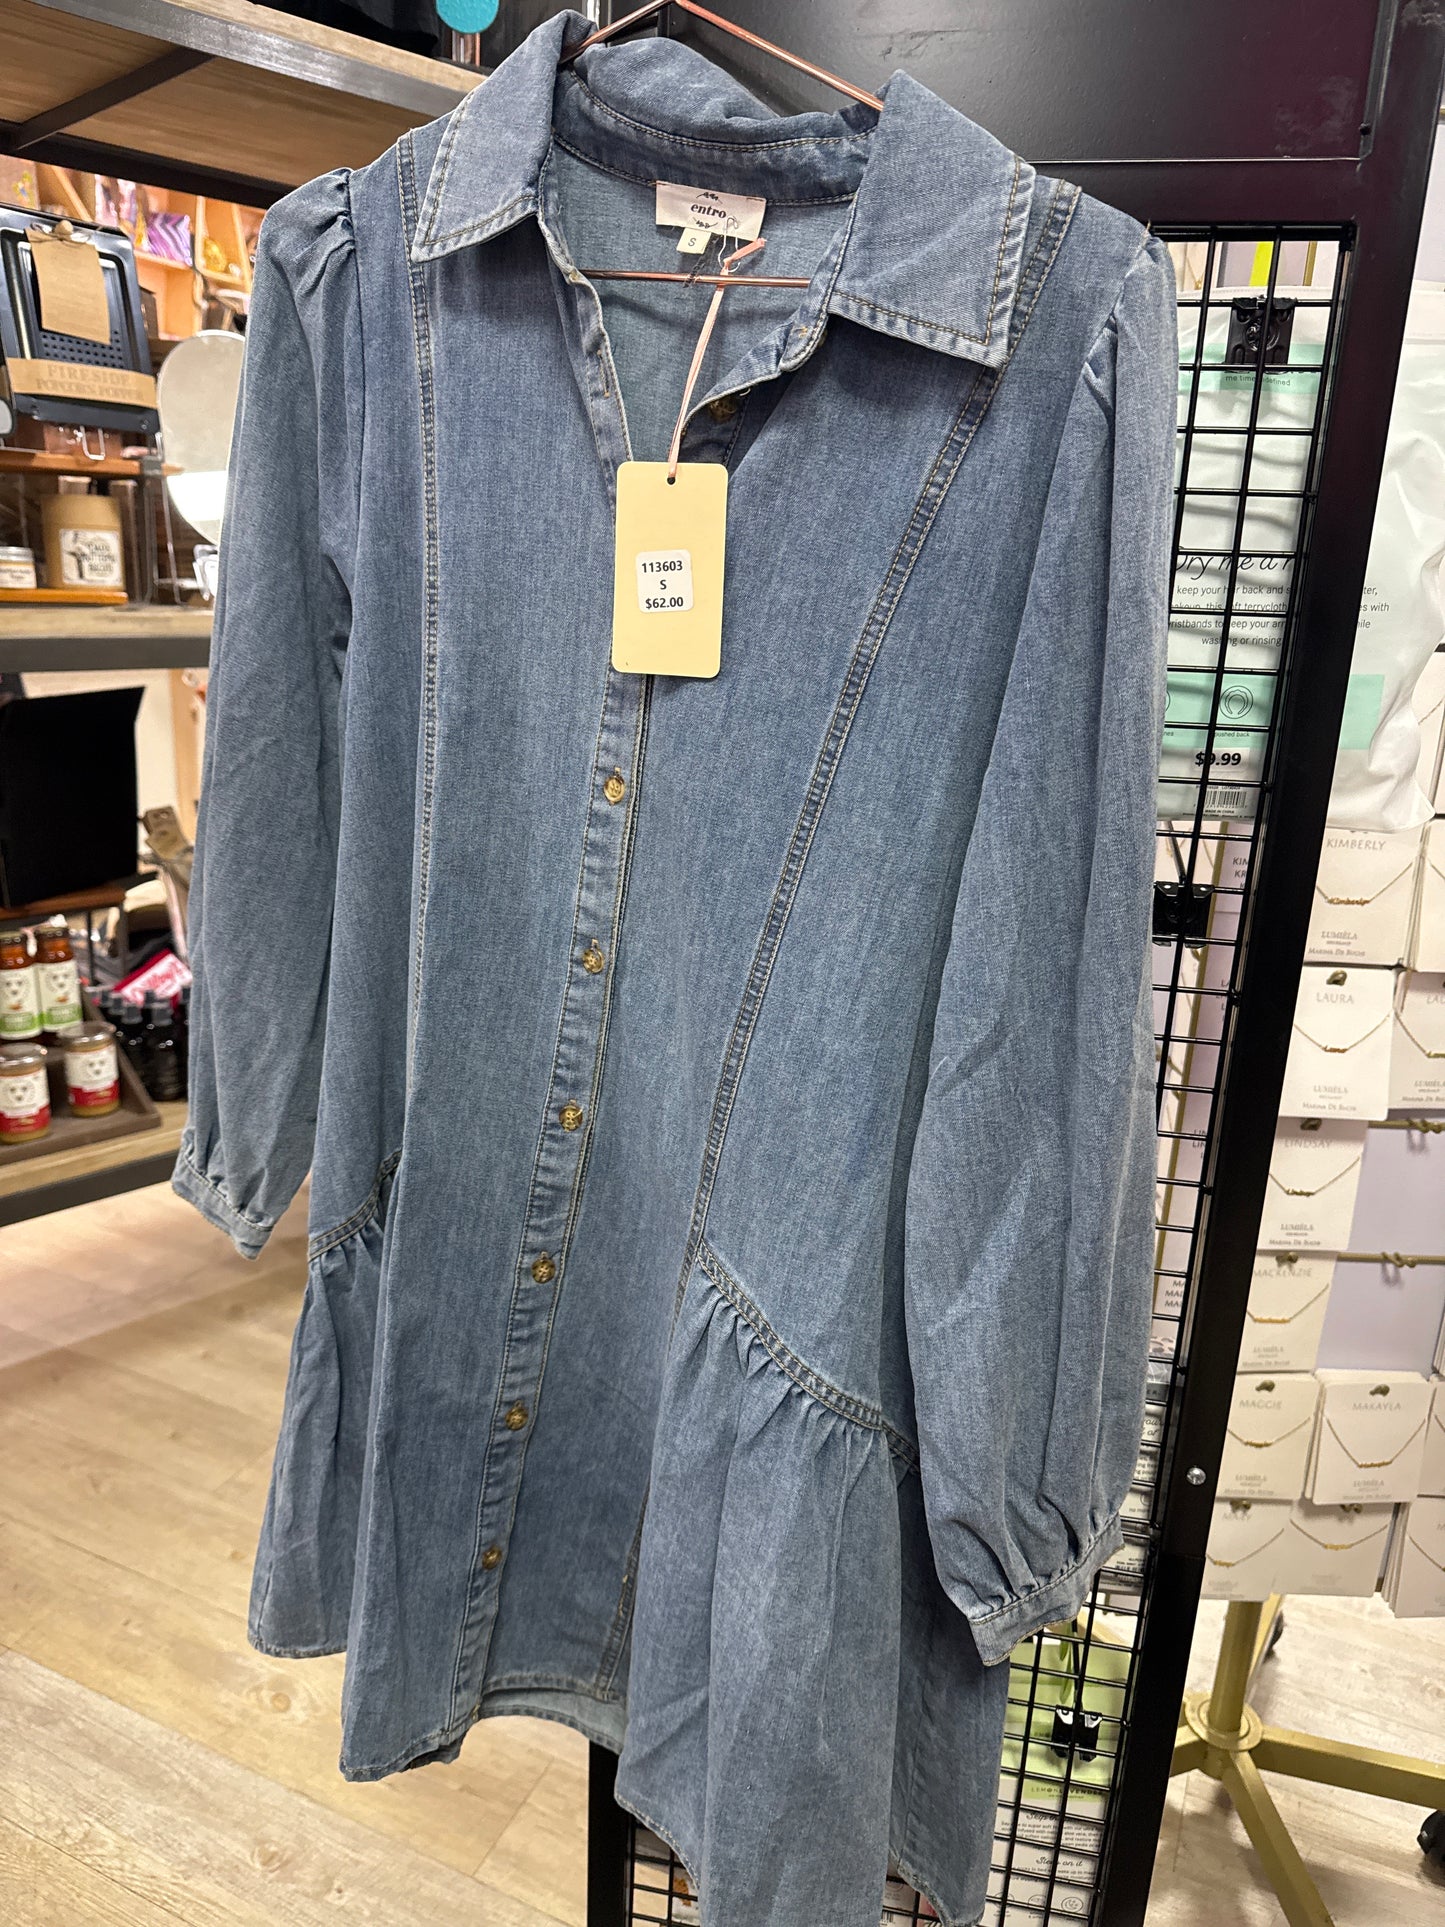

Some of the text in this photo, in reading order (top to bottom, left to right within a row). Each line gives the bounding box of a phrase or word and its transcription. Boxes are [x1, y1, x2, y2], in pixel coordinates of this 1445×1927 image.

[690, 203, 727, 219] entro
[687, 237, 697, 247] S
[641, 560, 683, 573] 113603
[659, 579, 667, 590] S
[1177, 585, 1199, 596] keep
[1200, 586, 1221, 596] your
[1223, 585, 1240, 594] hr
[1242, 585, 1263, 594] back
[1266, 585, 1283, 595] and
[645, 596, 684, 610] $62.00
[1371, 602, 1389, 612] with
[1215, 620, 1224, 628] to
[1230, 621, 1248, 630] eep
[1249, 621, 1271, 631] your
[1251, 636, 1282, 648] rinsing
[1326, 838, 1387, 851] KIMBERLY
[1315, 992, 1355, 1005] LAURA
[1283, 1139, 1332, 1149] LINDSAY
